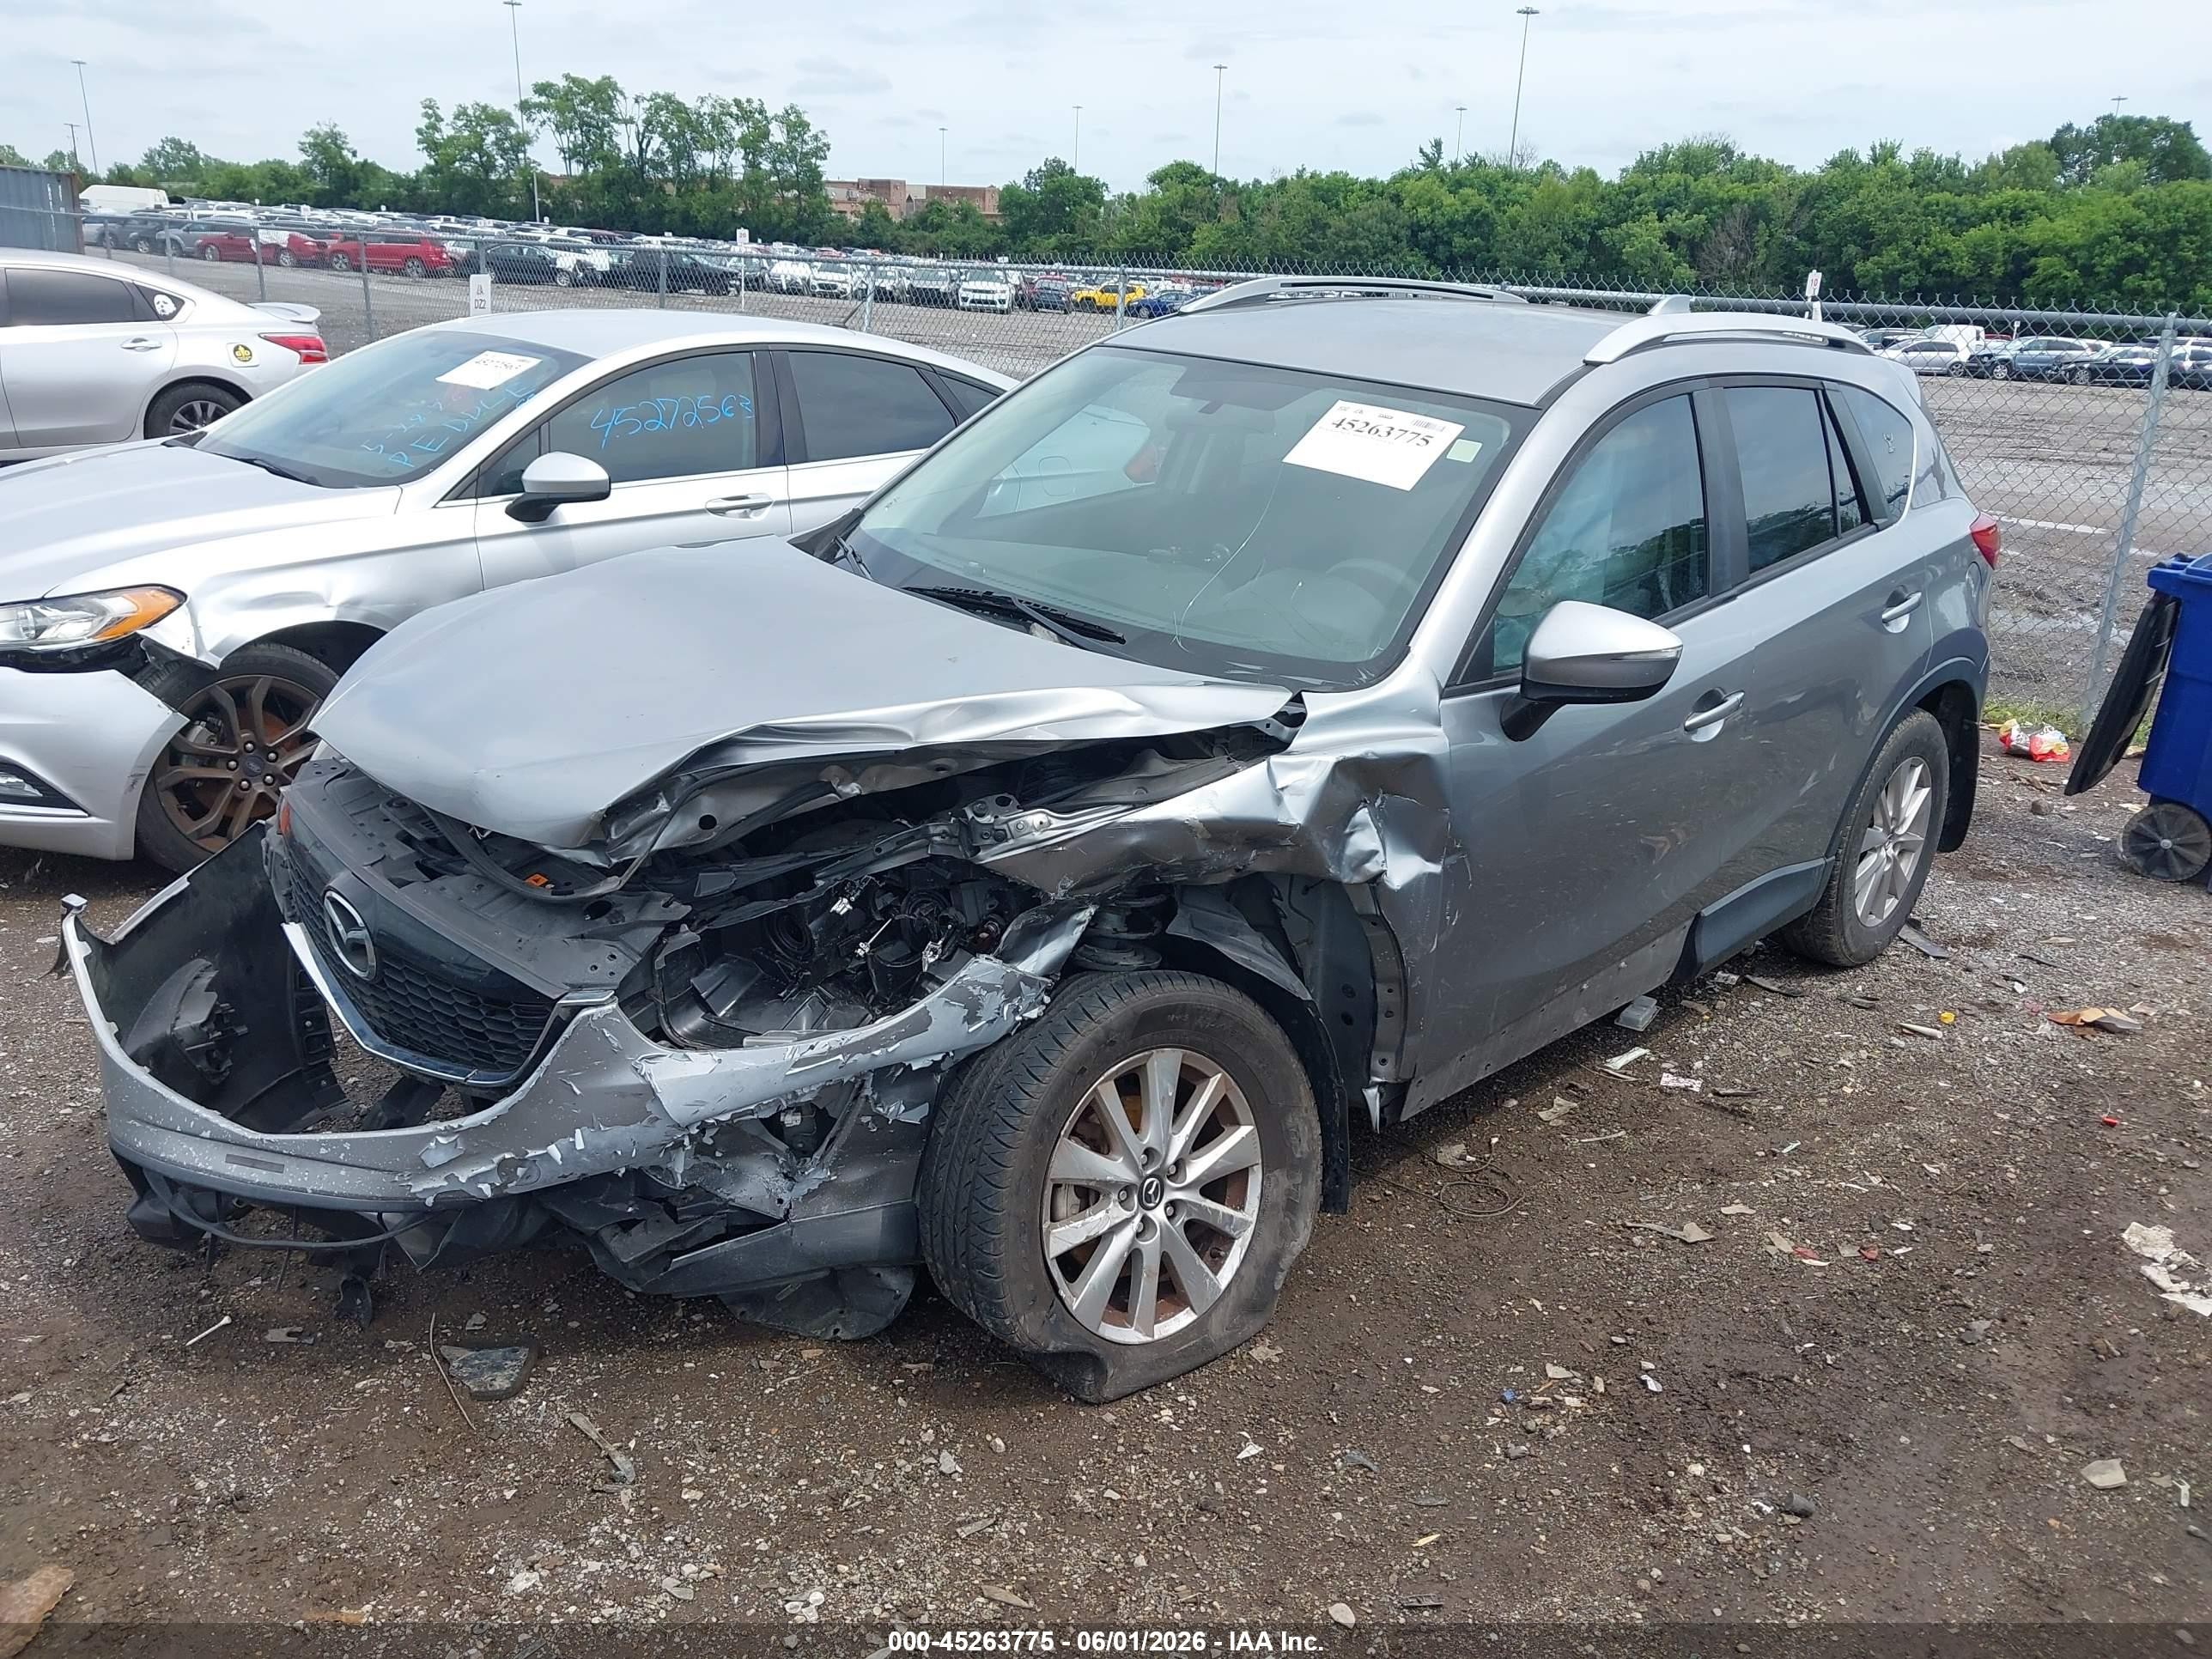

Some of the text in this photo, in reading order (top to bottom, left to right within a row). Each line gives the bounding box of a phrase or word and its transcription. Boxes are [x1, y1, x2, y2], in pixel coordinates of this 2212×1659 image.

[1810, 277, 1819, 288] 10
[590, 393, 756, 450] 45272563
[1332, 416, 1434, 447] 45263775
